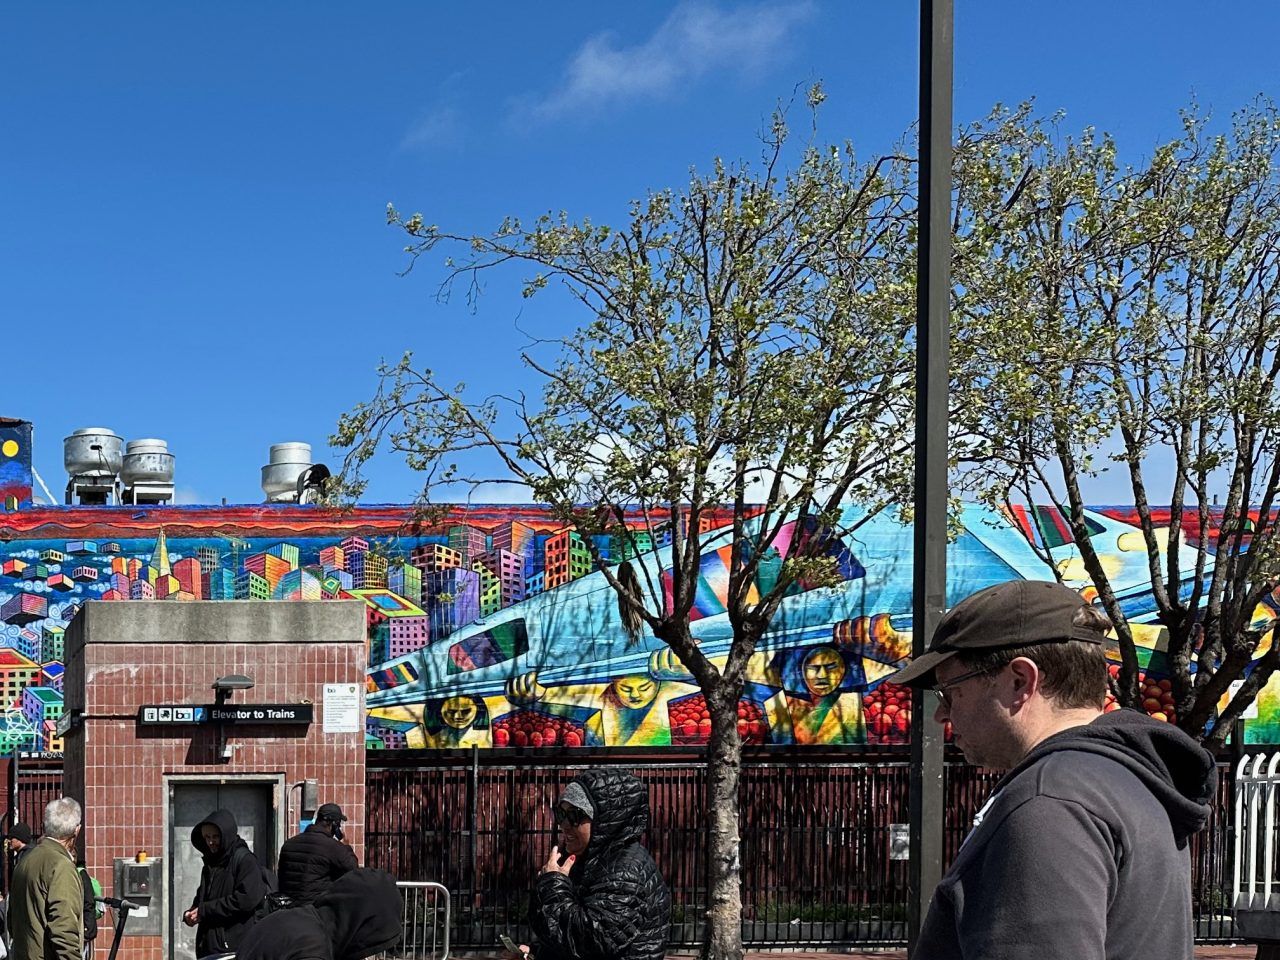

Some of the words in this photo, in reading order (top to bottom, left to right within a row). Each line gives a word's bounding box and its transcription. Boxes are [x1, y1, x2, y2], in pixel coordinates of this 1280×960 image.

[212, 709, 251, 719] Elevator
[253, 710, 265, 719] to
[267, 709, 295, 719] Trains
